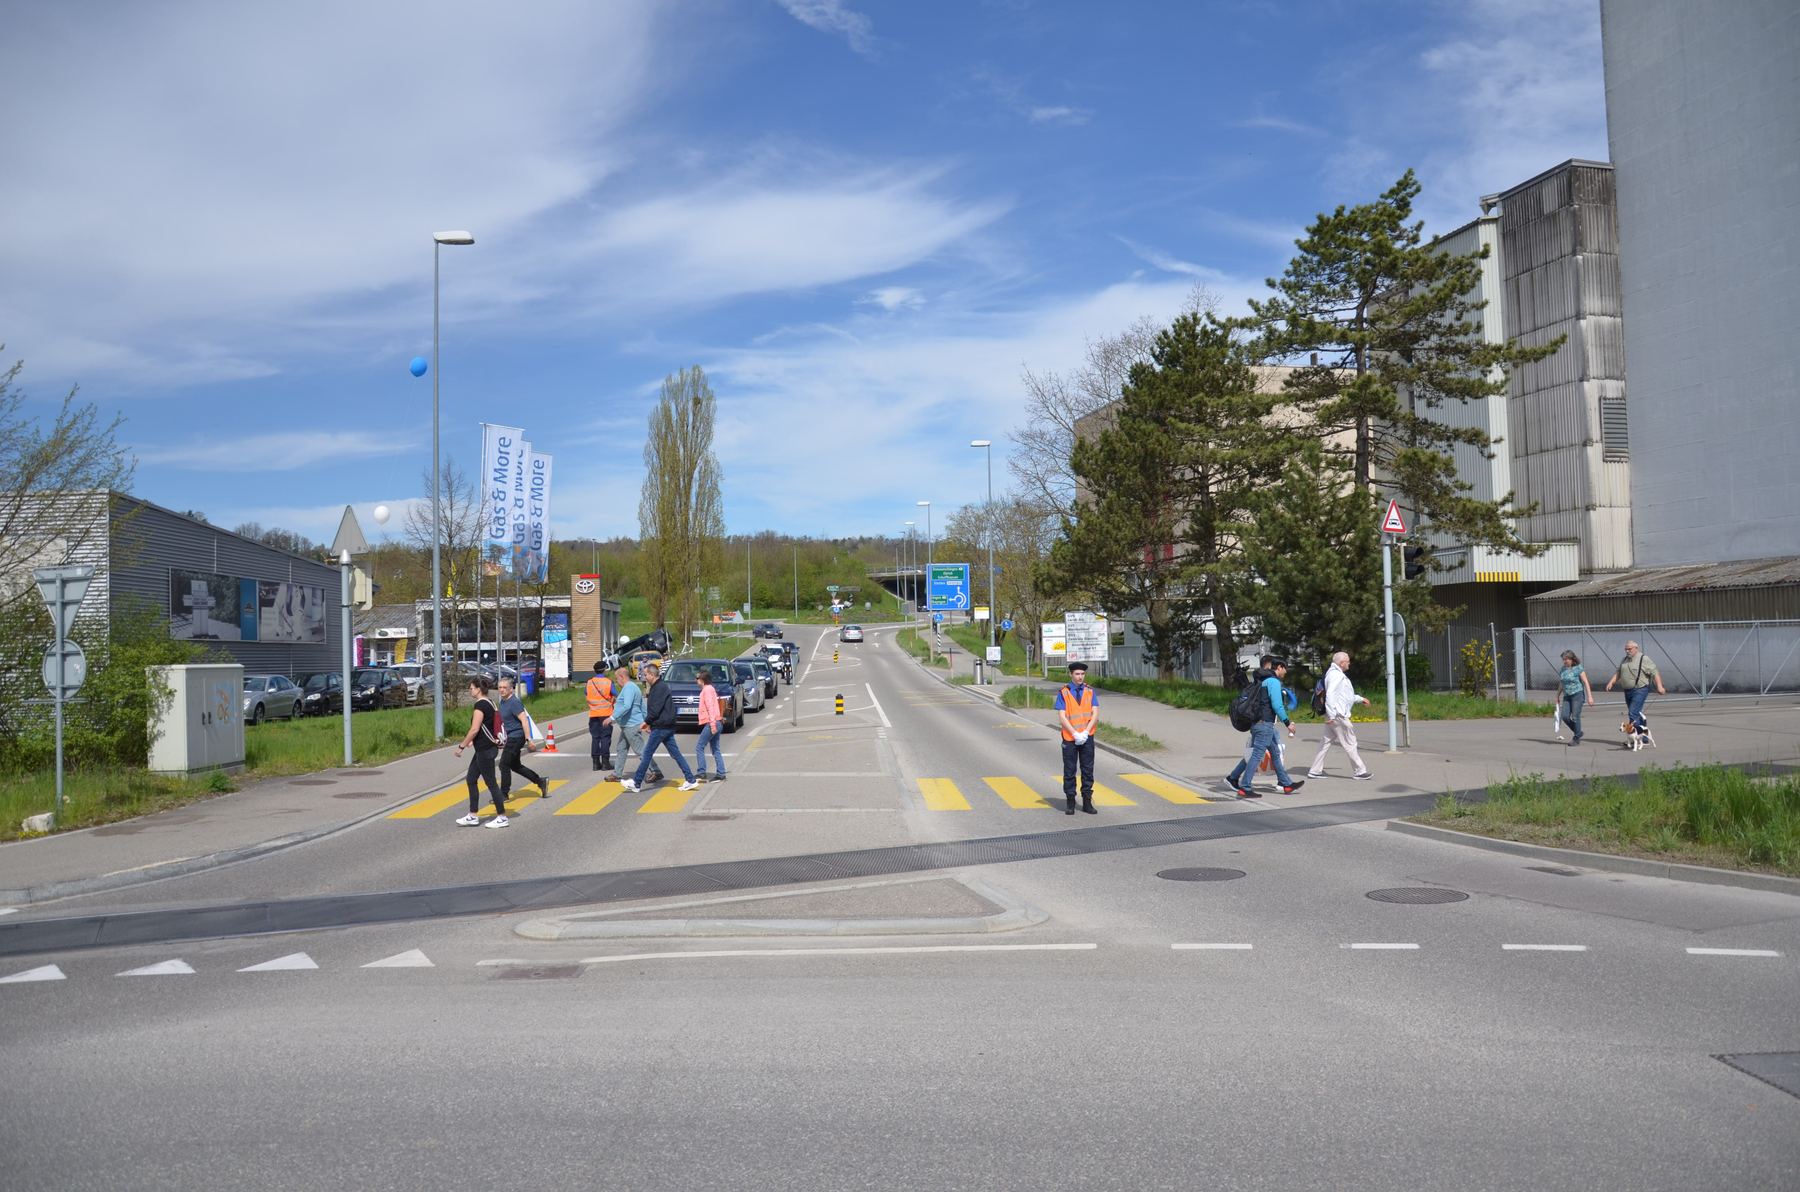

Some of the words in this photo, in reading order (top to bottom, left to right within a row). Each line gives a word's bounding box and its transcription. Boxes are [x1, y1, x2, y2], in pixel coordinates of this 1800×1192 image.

[493, 436, 512, 484] More
[491, 487, 507, 502] &
[530, 459, 545, 502] More
[489, 506, 506, 540] Gas
[530, 506, 543, 518] &
[530, 522, 543, 551] Gas
